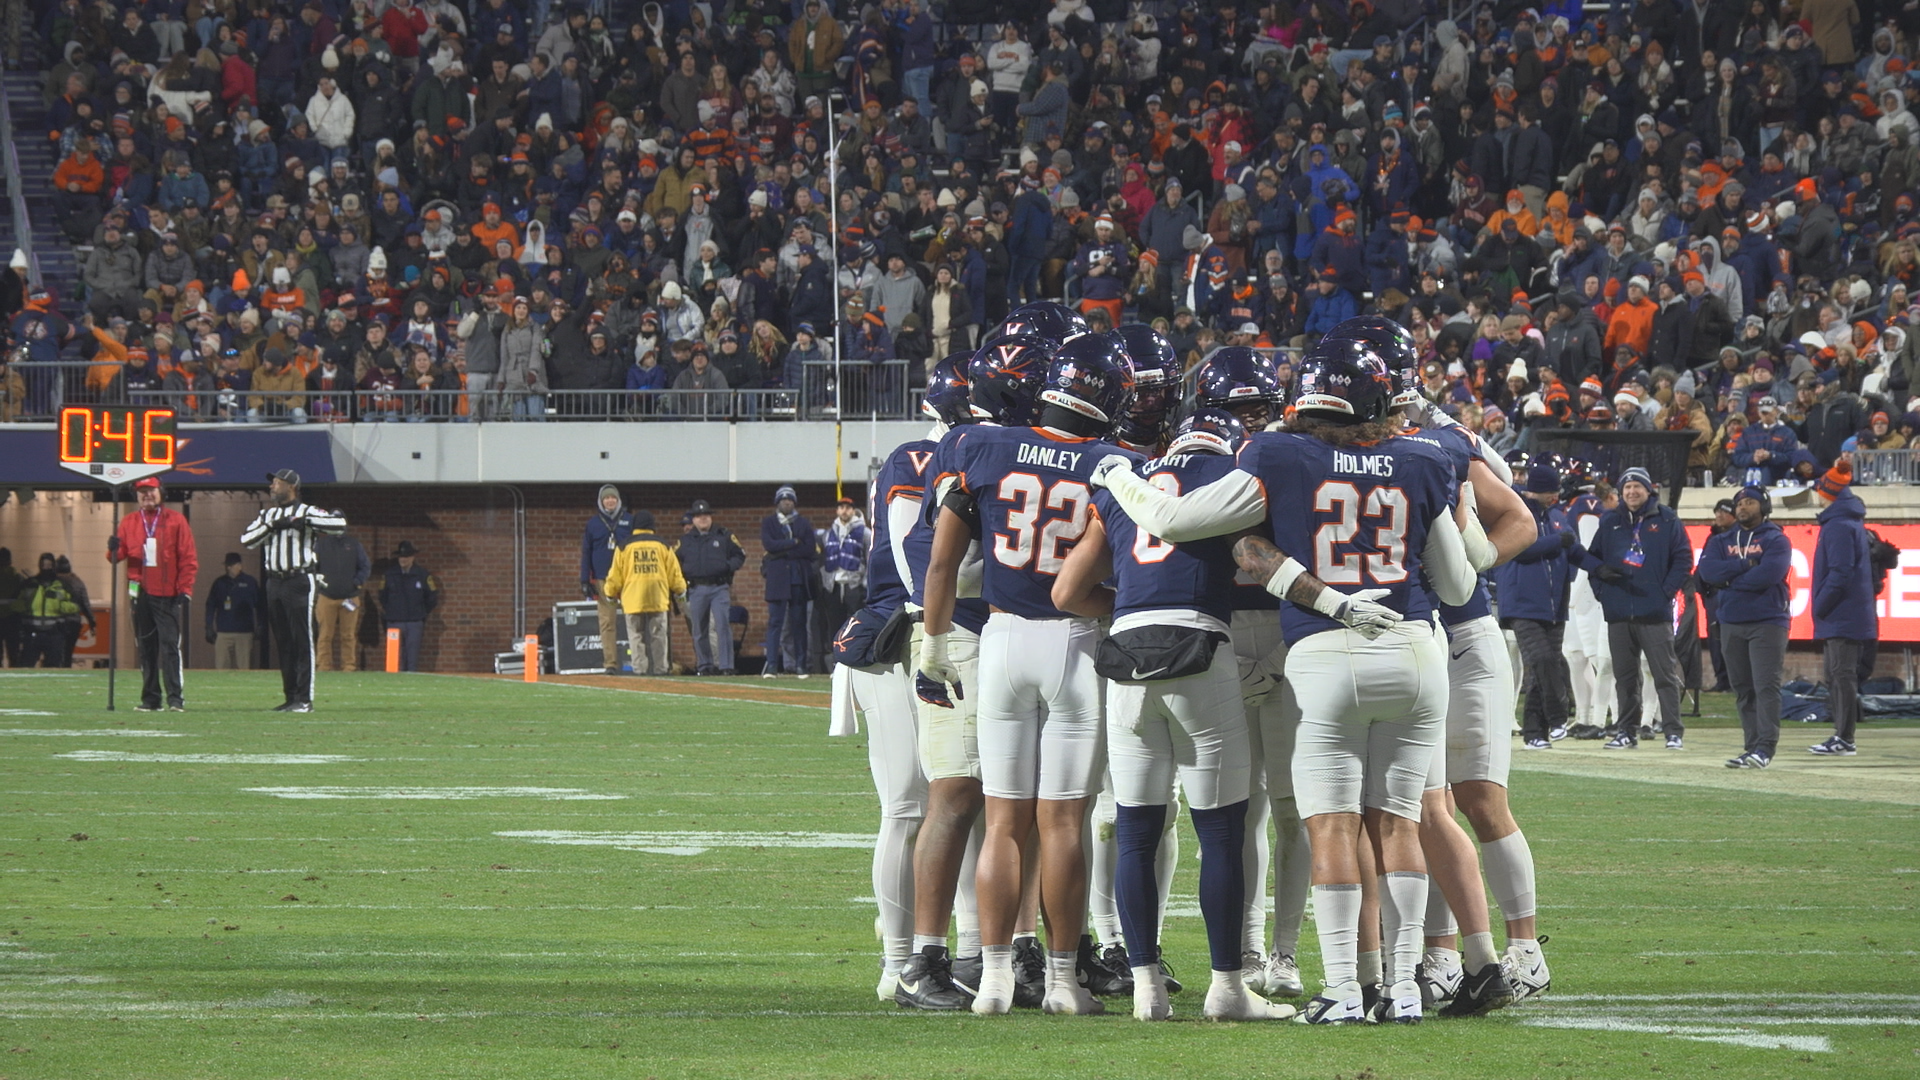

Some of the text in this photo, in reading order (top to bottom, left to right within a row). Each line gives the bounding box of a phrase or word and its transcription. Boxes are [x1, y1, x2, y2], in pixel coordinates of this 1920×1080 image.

[997, 345, 1027, 367] V
[1395, 396, 1409, 404] FOR
[61, 407, 174, 465] 0:46
[1017, 442, 1083, 472] DANLEY
[1142, 454, 1194, 475] CLARY
[1333, 450, 1394, 478] HOLMES
[993, 472, 1093, 576] 32
[1313, 479, 1409, 584] 23
[634, 564, 658, 574] EVENTS
